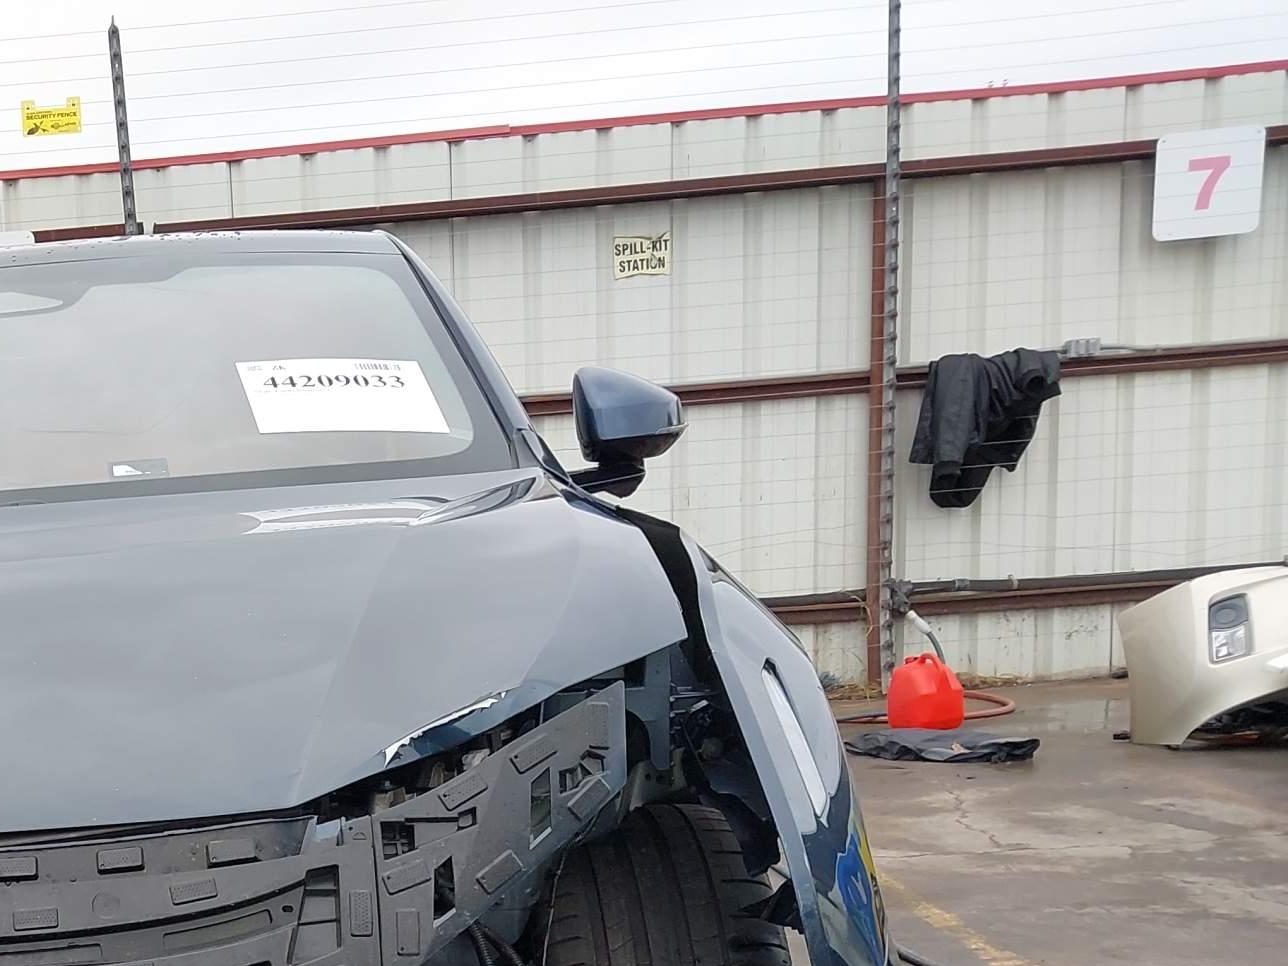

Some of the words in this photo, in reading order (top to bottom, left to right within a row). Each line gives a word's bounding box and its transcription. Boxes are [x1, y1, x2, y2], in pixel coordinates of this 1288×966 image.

[26, 113, 56, 121] SECURITY
[1187, 155, 1232, 211] 7
[614, 239, 670, 256] SPILL-KIT
[618, 256, 666, 273] STATION
[263, 374, 406, 389] 44209033
